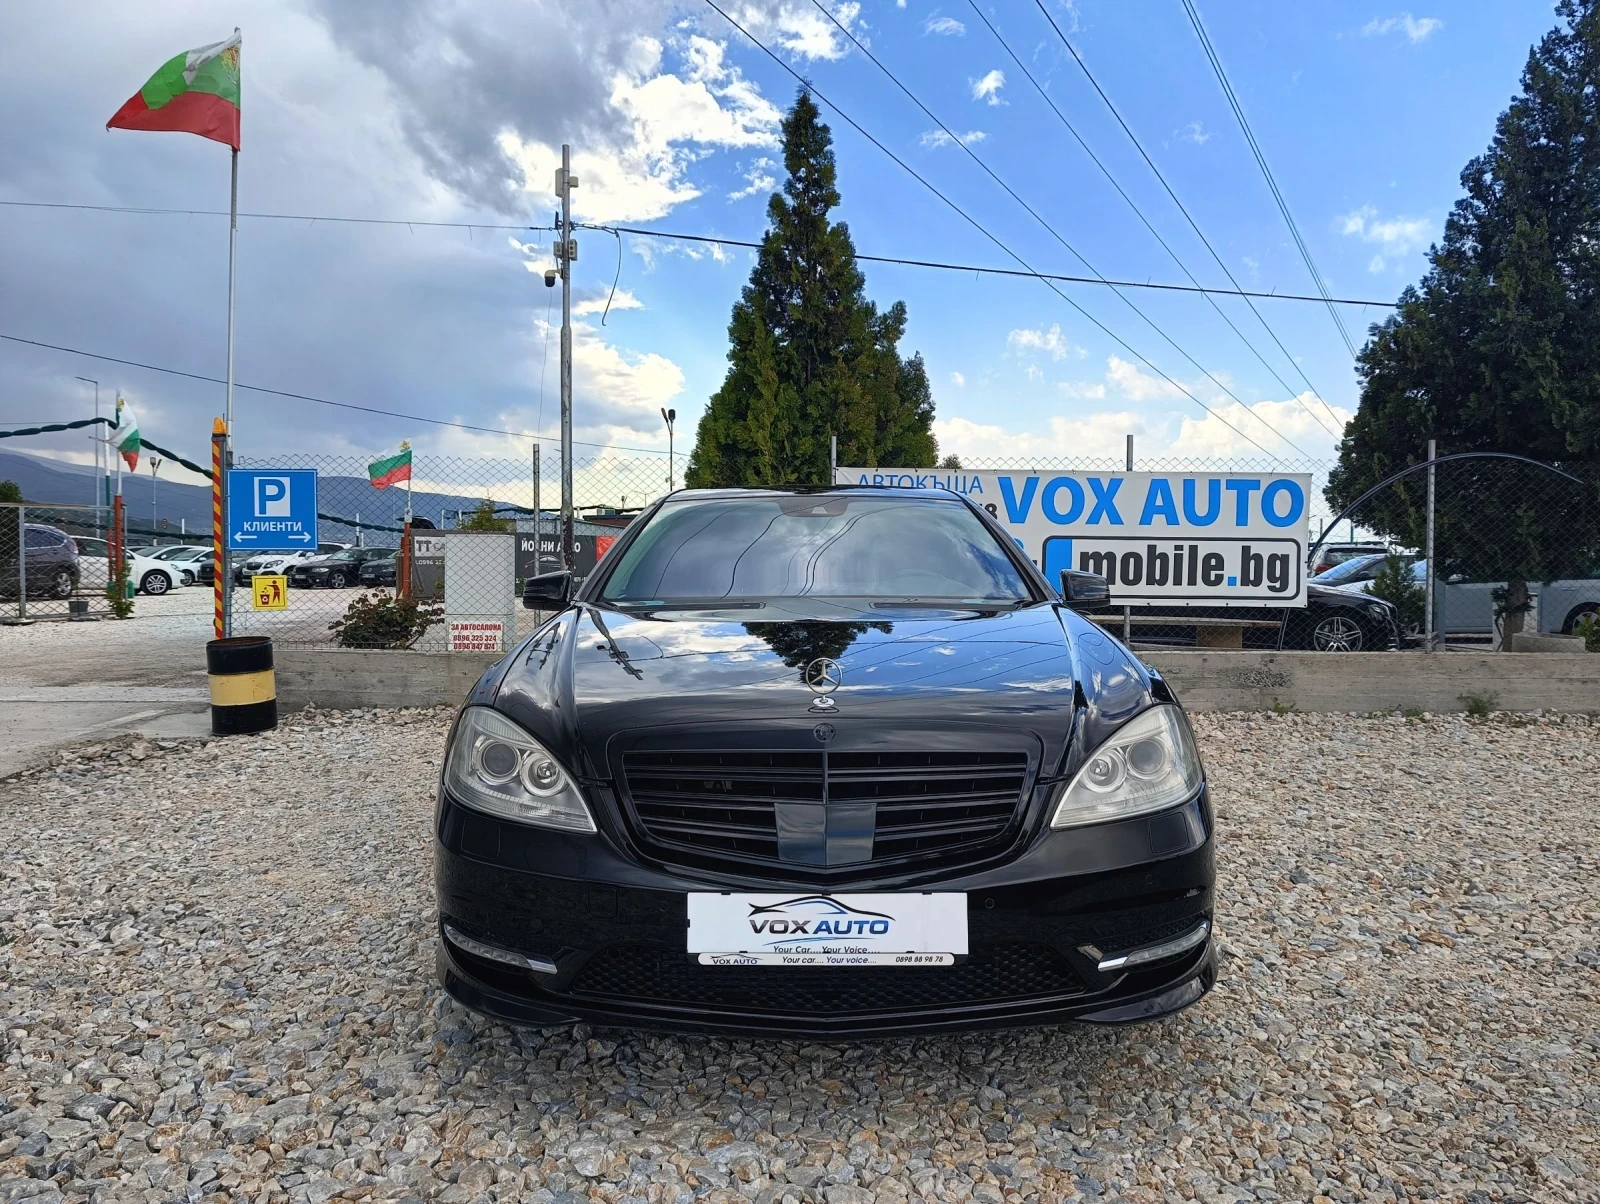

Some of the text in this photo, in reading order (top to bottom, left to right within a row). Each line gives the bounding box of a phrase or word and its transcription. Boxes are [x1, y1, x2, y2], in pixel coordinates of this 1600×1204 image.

[859, 474, 983, 495] АВТОКЪЩА
[258, 479, 286, 515] P
[997, 476, 1304, 528] VOX AUTO
[243, 521, 302, 532] КЛИЕНТИ
[415, 540, 432, 552] TT
[521, 538, 554, 552] ЙОНИ
[1079, 544, 1290, 593] mobile.bg
[451, 623, 460, 631] ЗА
[471, 634, 484, 642] 325
[484, 634, 497, 642] 324
[750, 919, 889, 935] VOX AUTO
[782, 956, 801, 964] Your
[826, 956, 845, 964] Your
